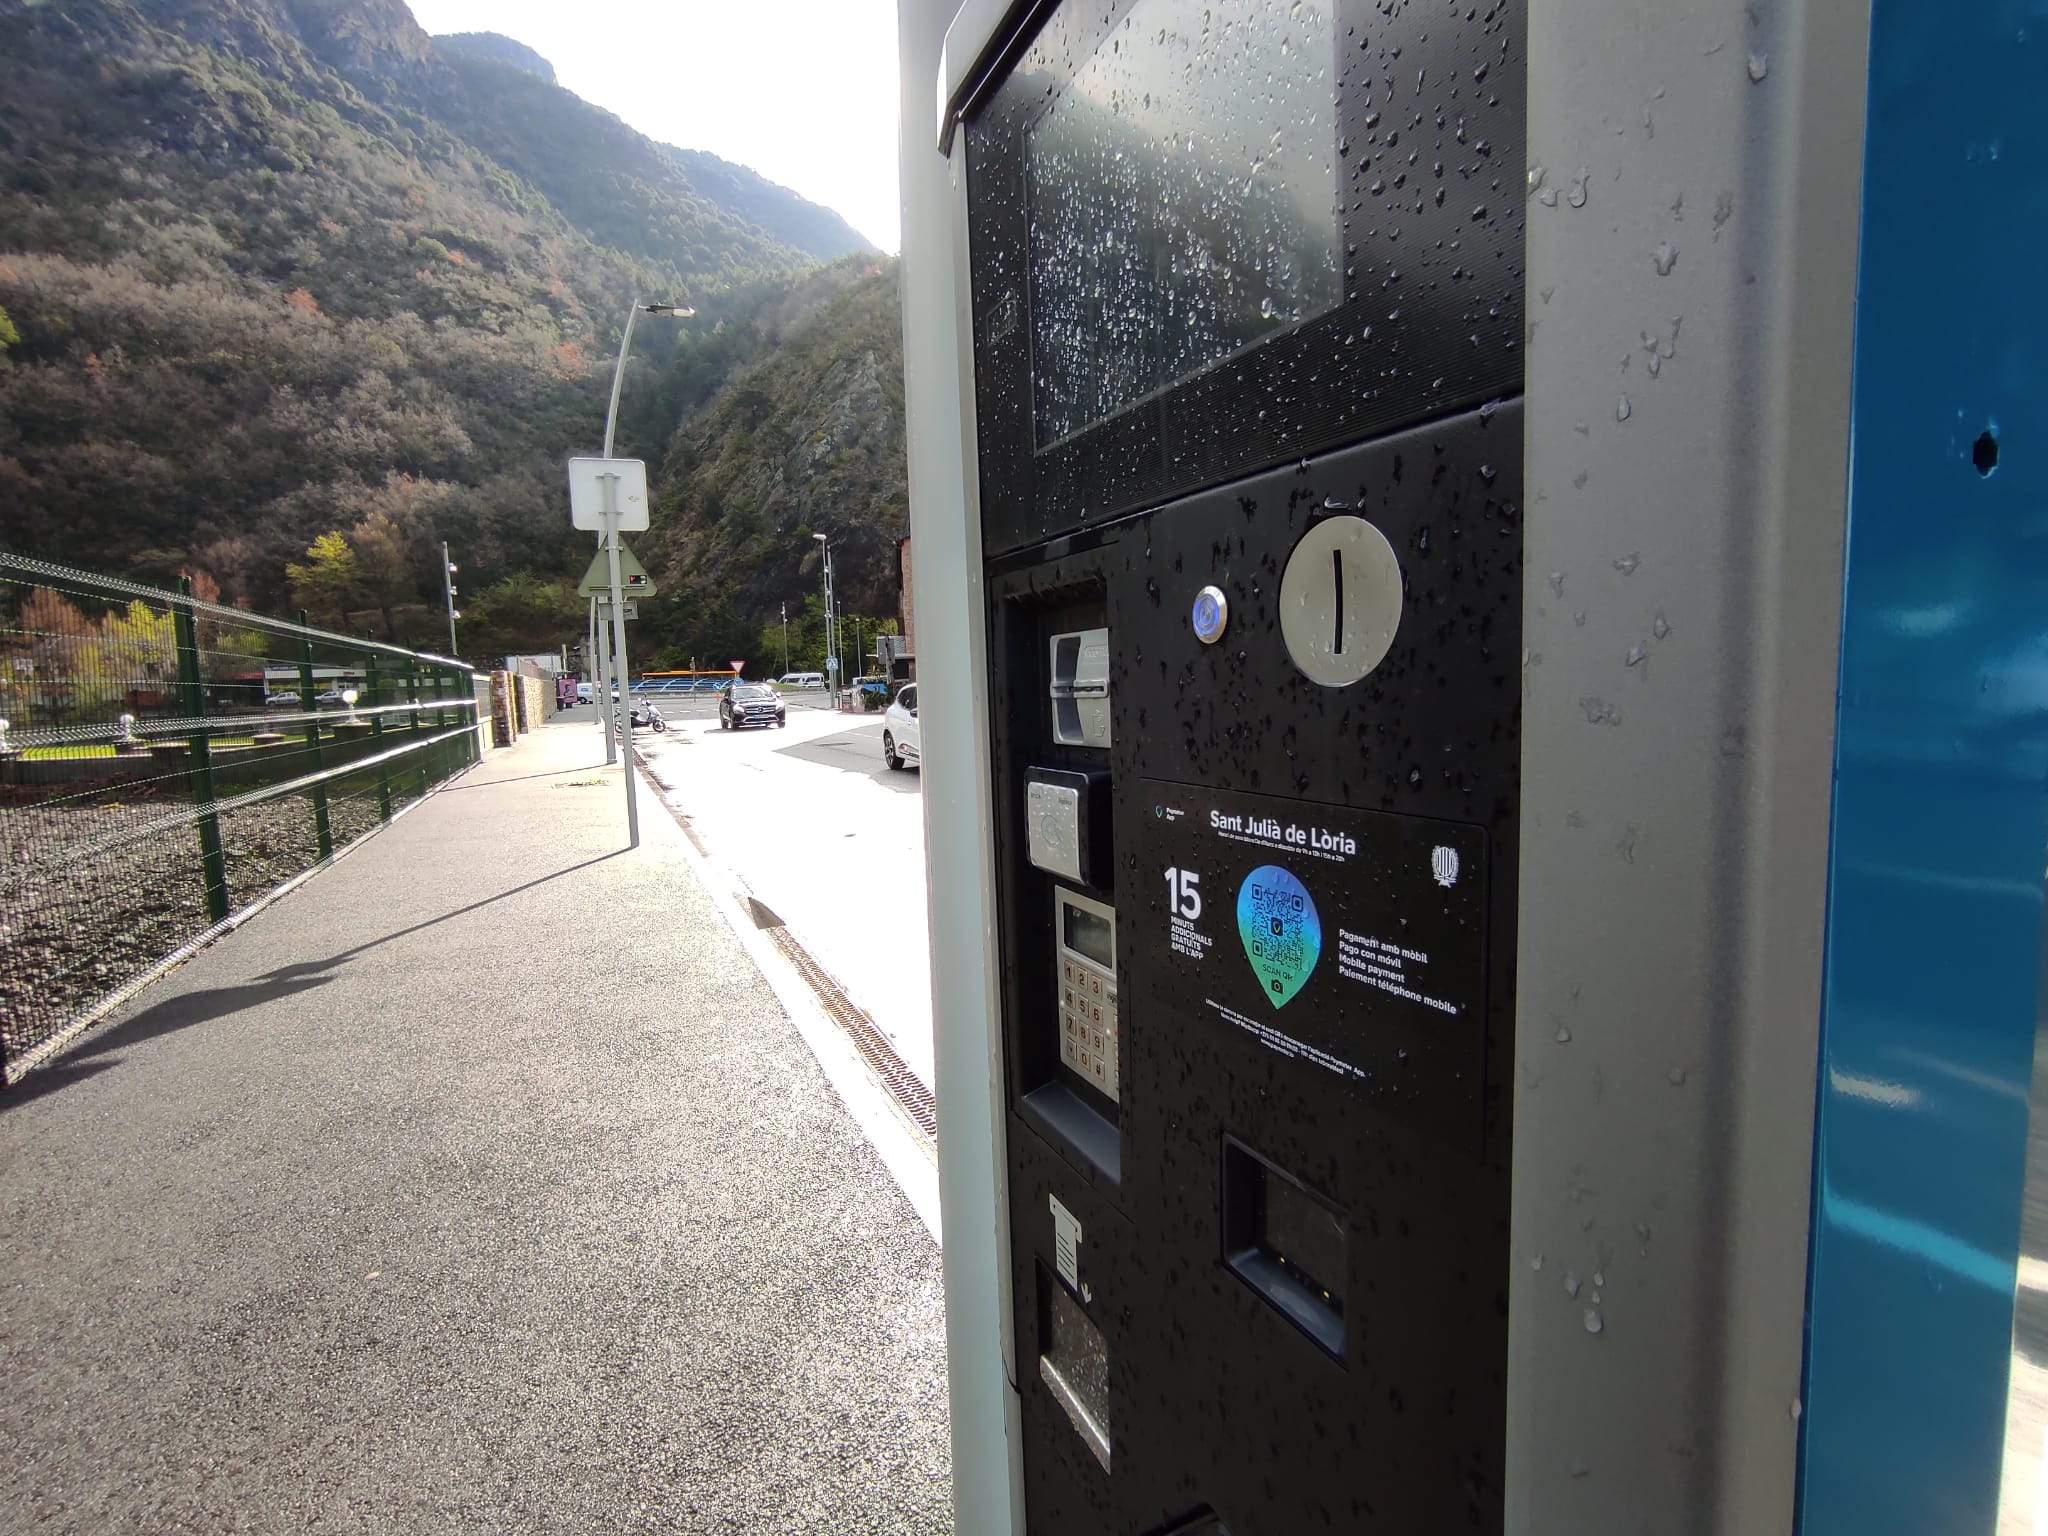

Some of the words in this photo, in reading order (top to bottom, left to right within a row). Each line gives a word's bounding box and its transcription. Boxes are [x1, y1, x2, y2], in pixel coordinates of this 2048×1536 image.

[1209, 810, 1242, 832] Sant
[1245, 816, 1281, 840] Julià
[1285, 824, 1307, 845] de
[1311, 827, 1356, 855] Lòria
[1164, 867, 1201, 920] 15
[1339, 929, 1379, 948] Pagament
[1381, 944, 1400, 955] amb
[1401, 949, 1428, 963] mòbil
[1339, 941, 1359, 954] Pago
[1361, 948, 1376, 960] con
[1377, 953, 1402, 968] móvil
[1339, 953, 1366, 970] Mobile
[1367, 964, 1405, 983] payment
[1339, 965, 1376, 986] Paiement
[1378, 980, 1422, 1002] téléphone
[1423, 995, 1457, 1014] mobile
